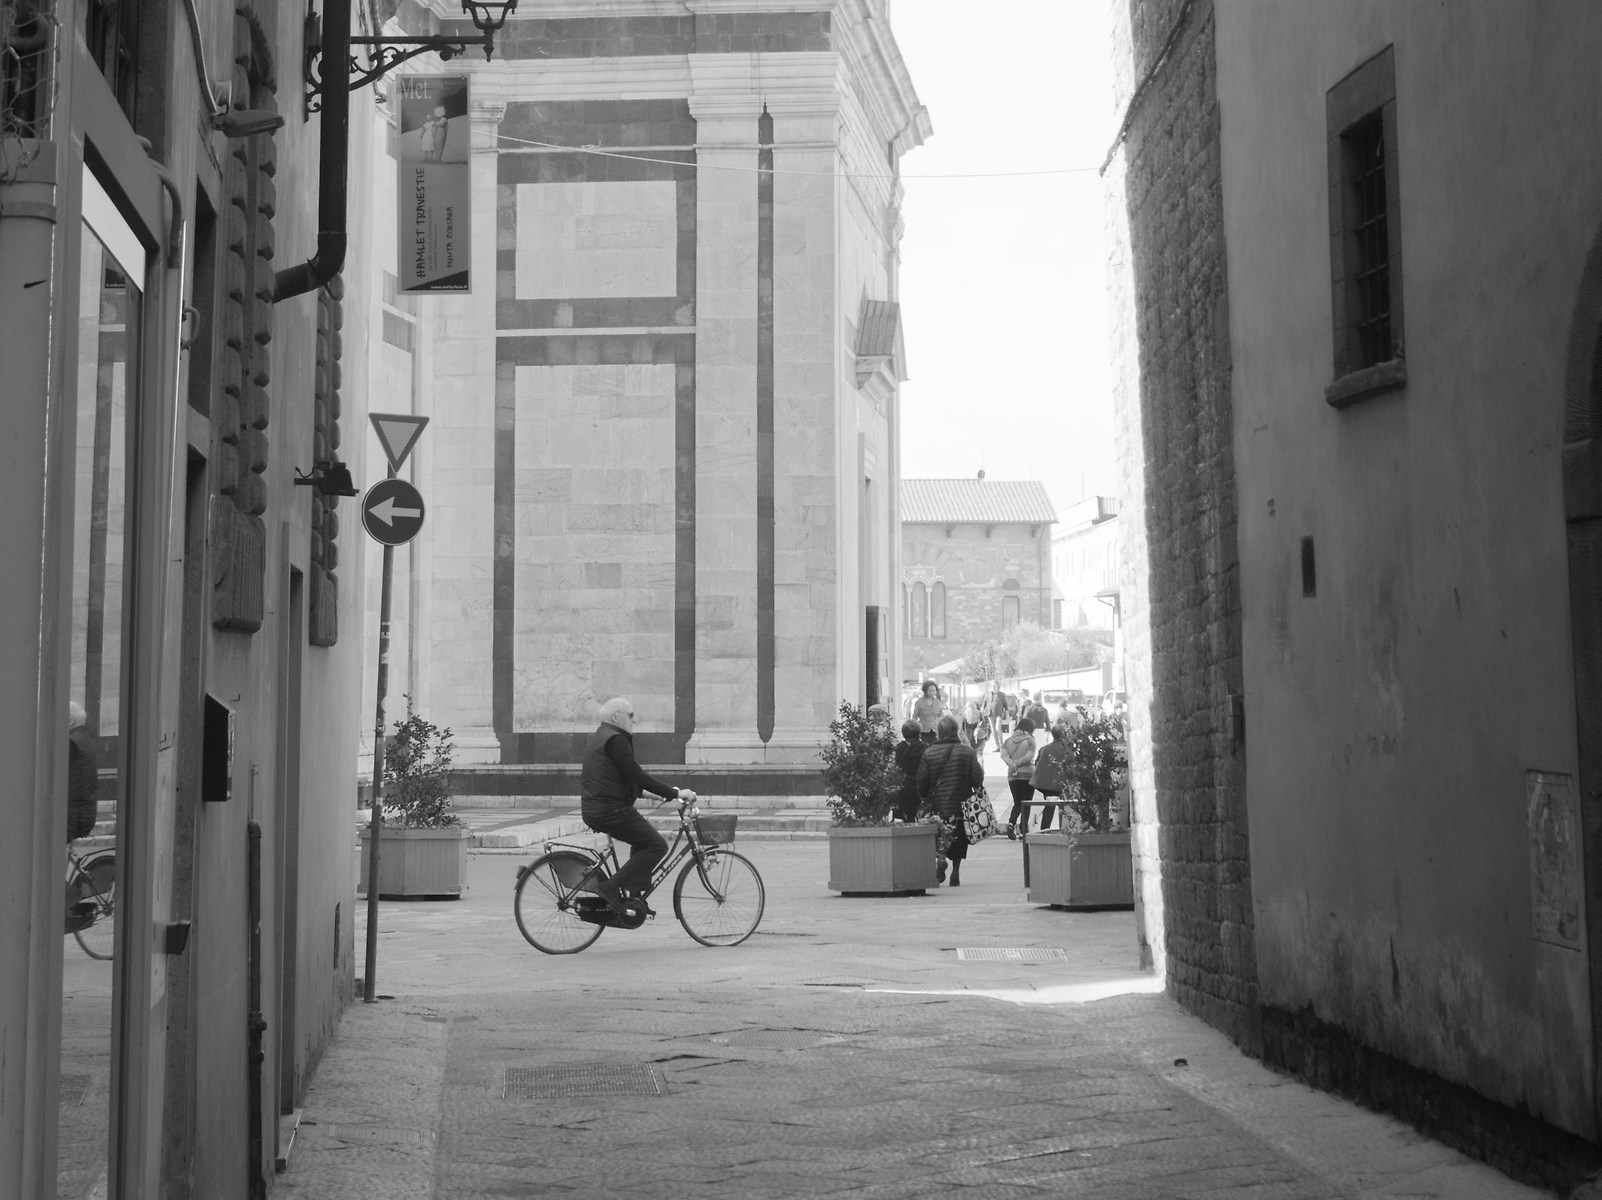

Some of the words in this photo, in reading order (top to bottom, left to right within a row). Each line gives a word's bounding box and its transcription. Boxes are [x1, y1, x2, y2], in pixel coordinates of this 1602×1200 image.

[401, 77, 432, 100] Met.
[416, 167, 426, 226] TRAVESTIE
[416, 228, 426, 278] HAMLET
